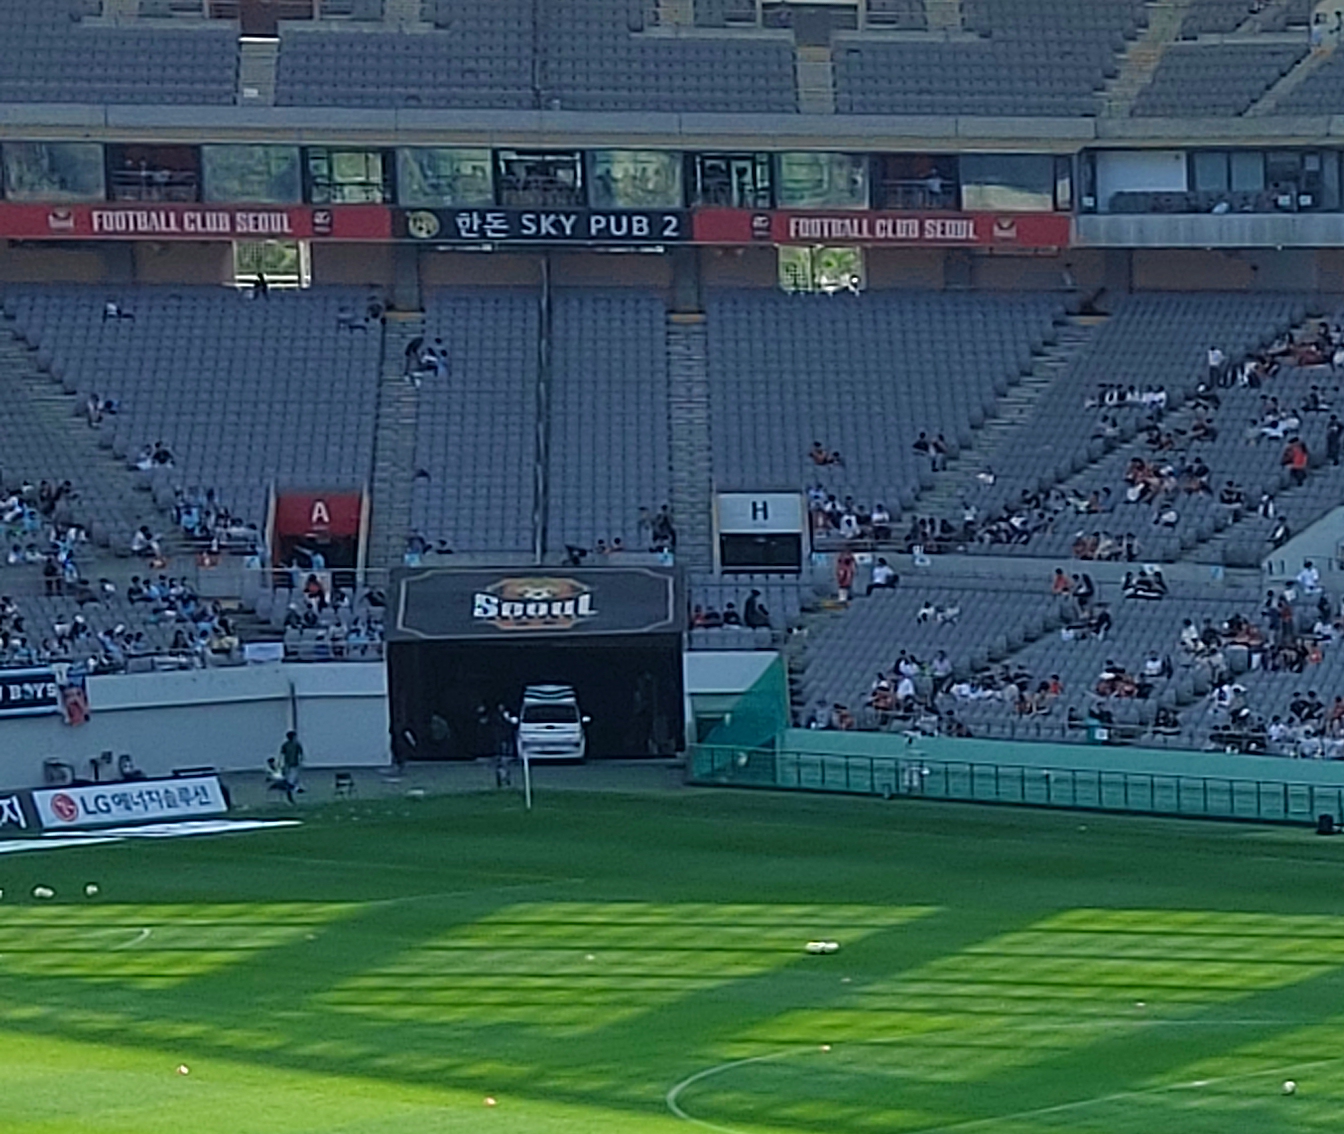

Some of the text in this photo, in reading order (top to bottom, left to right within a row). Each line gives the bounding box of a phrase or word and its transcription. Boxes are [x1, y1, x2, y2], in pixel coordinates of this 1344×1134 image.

[92, 211, 293, 233] FOOTBALL CLUB SEOUL
[456, 212, 680, 238] 한돈 SKY PUB 2
[789, 217, 979, 239] FOOTBALL CLUB SEOUL
[312, 500, 330, 523] A
[751, 500, 769, 521] H
